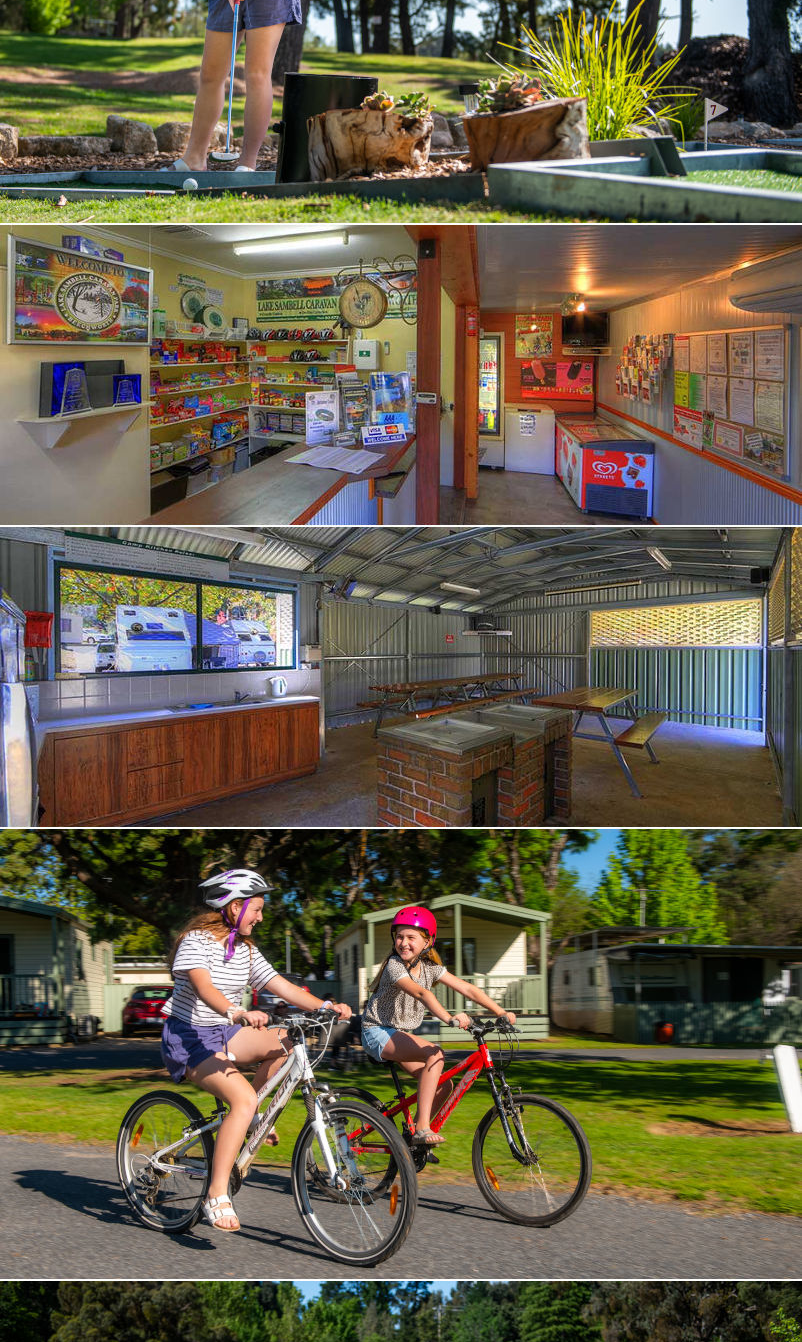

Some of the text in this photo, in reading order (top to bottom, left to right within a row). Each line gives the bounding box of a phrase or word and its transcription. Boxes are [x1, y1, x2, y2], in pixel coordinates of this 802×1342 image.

[710, 104, 717, 116] 7
[56, 253, 125, 276] WELCOME TO
[60, 274, 86, 292] SAMBELL
[57, 292, 67, 312] LAKE
[257, 301, 275, 312] LAKE
[275, 299, 306, 311] SAMBELL
[305, 297, 338, 309] CARAVAN
[67, 317, 114, 331] BEECHWORTH
[367, 435, 391, 443] WELCOME
[121, 540, 143, 549] Camp
[144, 544, 173, 553] Kitchen
